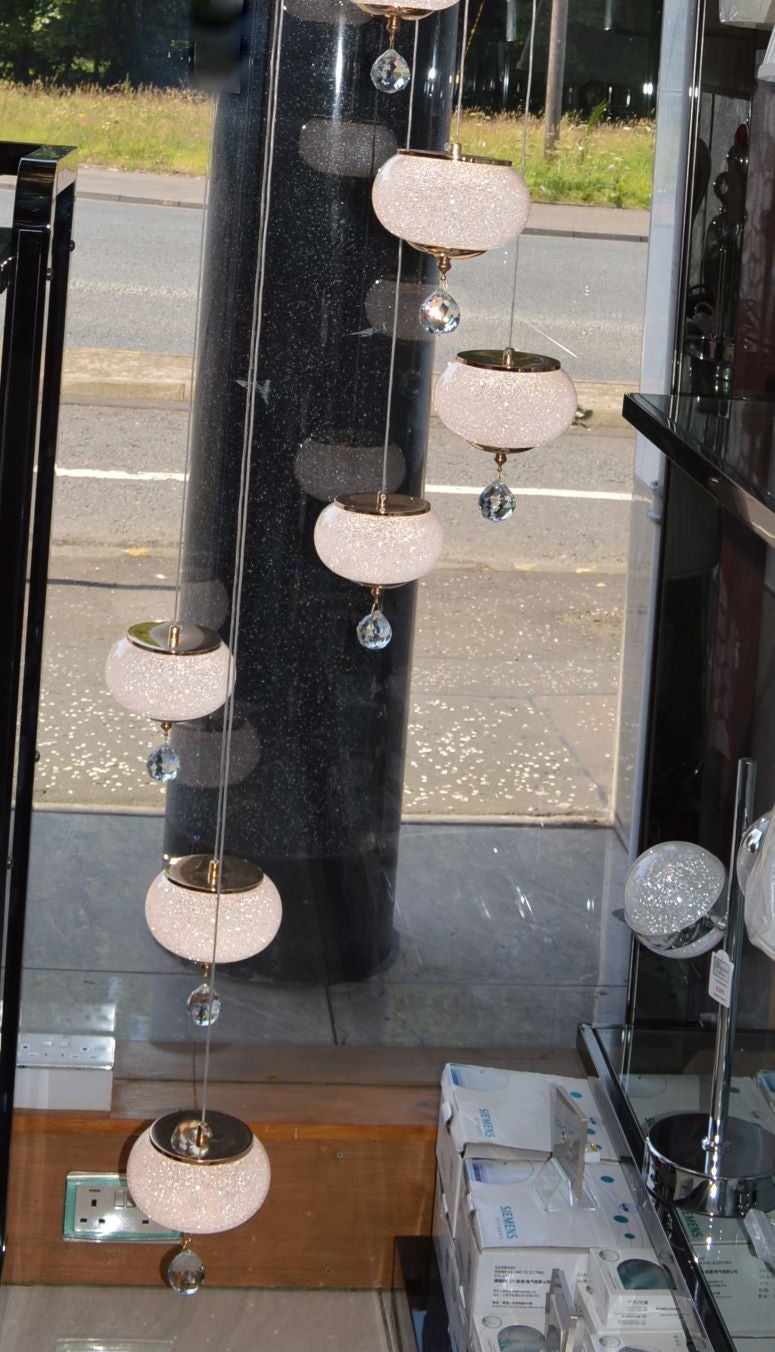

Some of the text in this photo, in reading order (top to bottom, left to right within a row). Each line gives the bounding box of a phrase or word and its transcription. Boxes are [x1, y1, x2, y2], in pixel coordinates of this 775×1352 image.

[479, 1108, 496, 1138] SIEMENS
[500, 1206, 518, 1239] SIEMENS
[682, 1211, 703, 1237] EMENS
